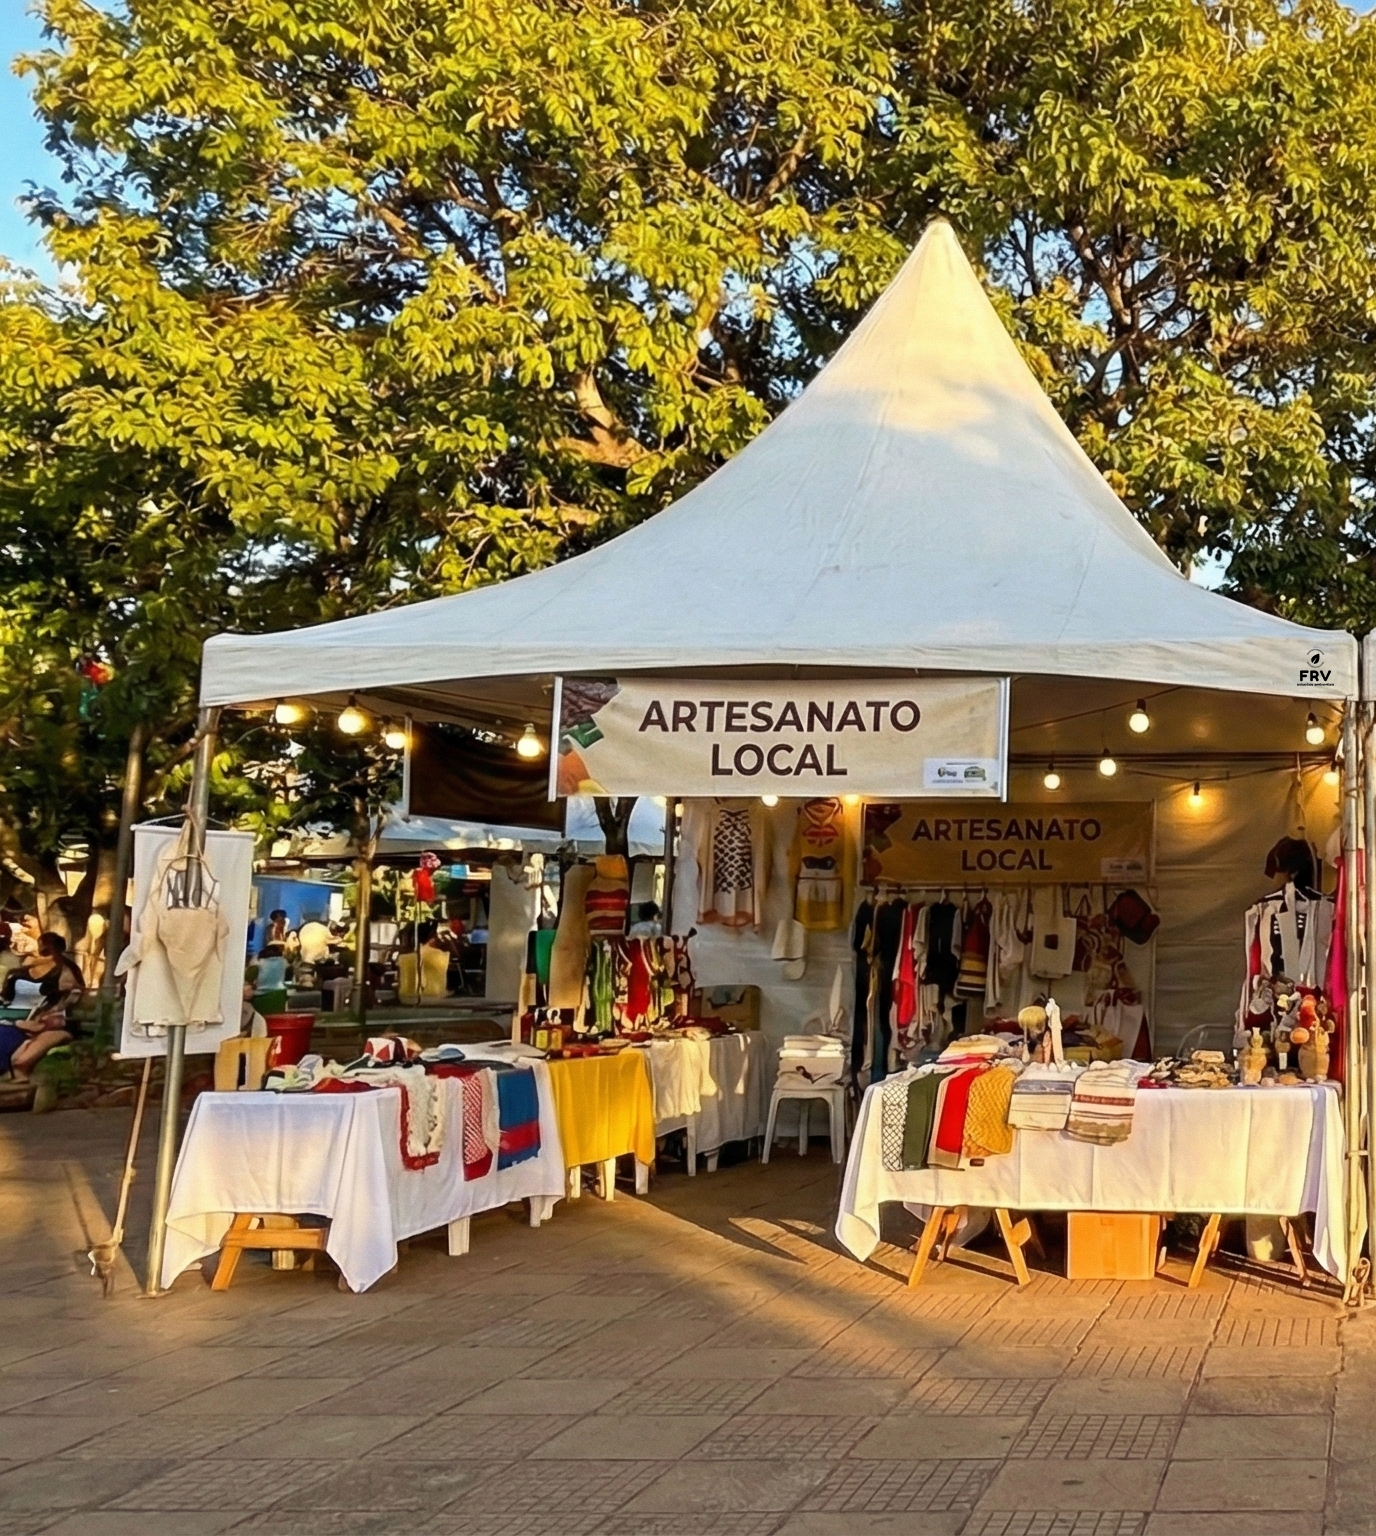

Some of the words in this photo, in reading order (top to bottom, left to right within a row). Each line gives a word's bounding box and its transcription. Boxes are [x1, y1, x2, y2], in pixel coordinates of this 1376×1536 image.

[1300, 670, 1331, 681] FRV
[638, 700, 921, 732] ARTESANATO
[711, 743, 848, 776] LOCAL
[911, 818, 1101, 841] ARTESANATO
[961, 849, 1053, 871] LOCAL
